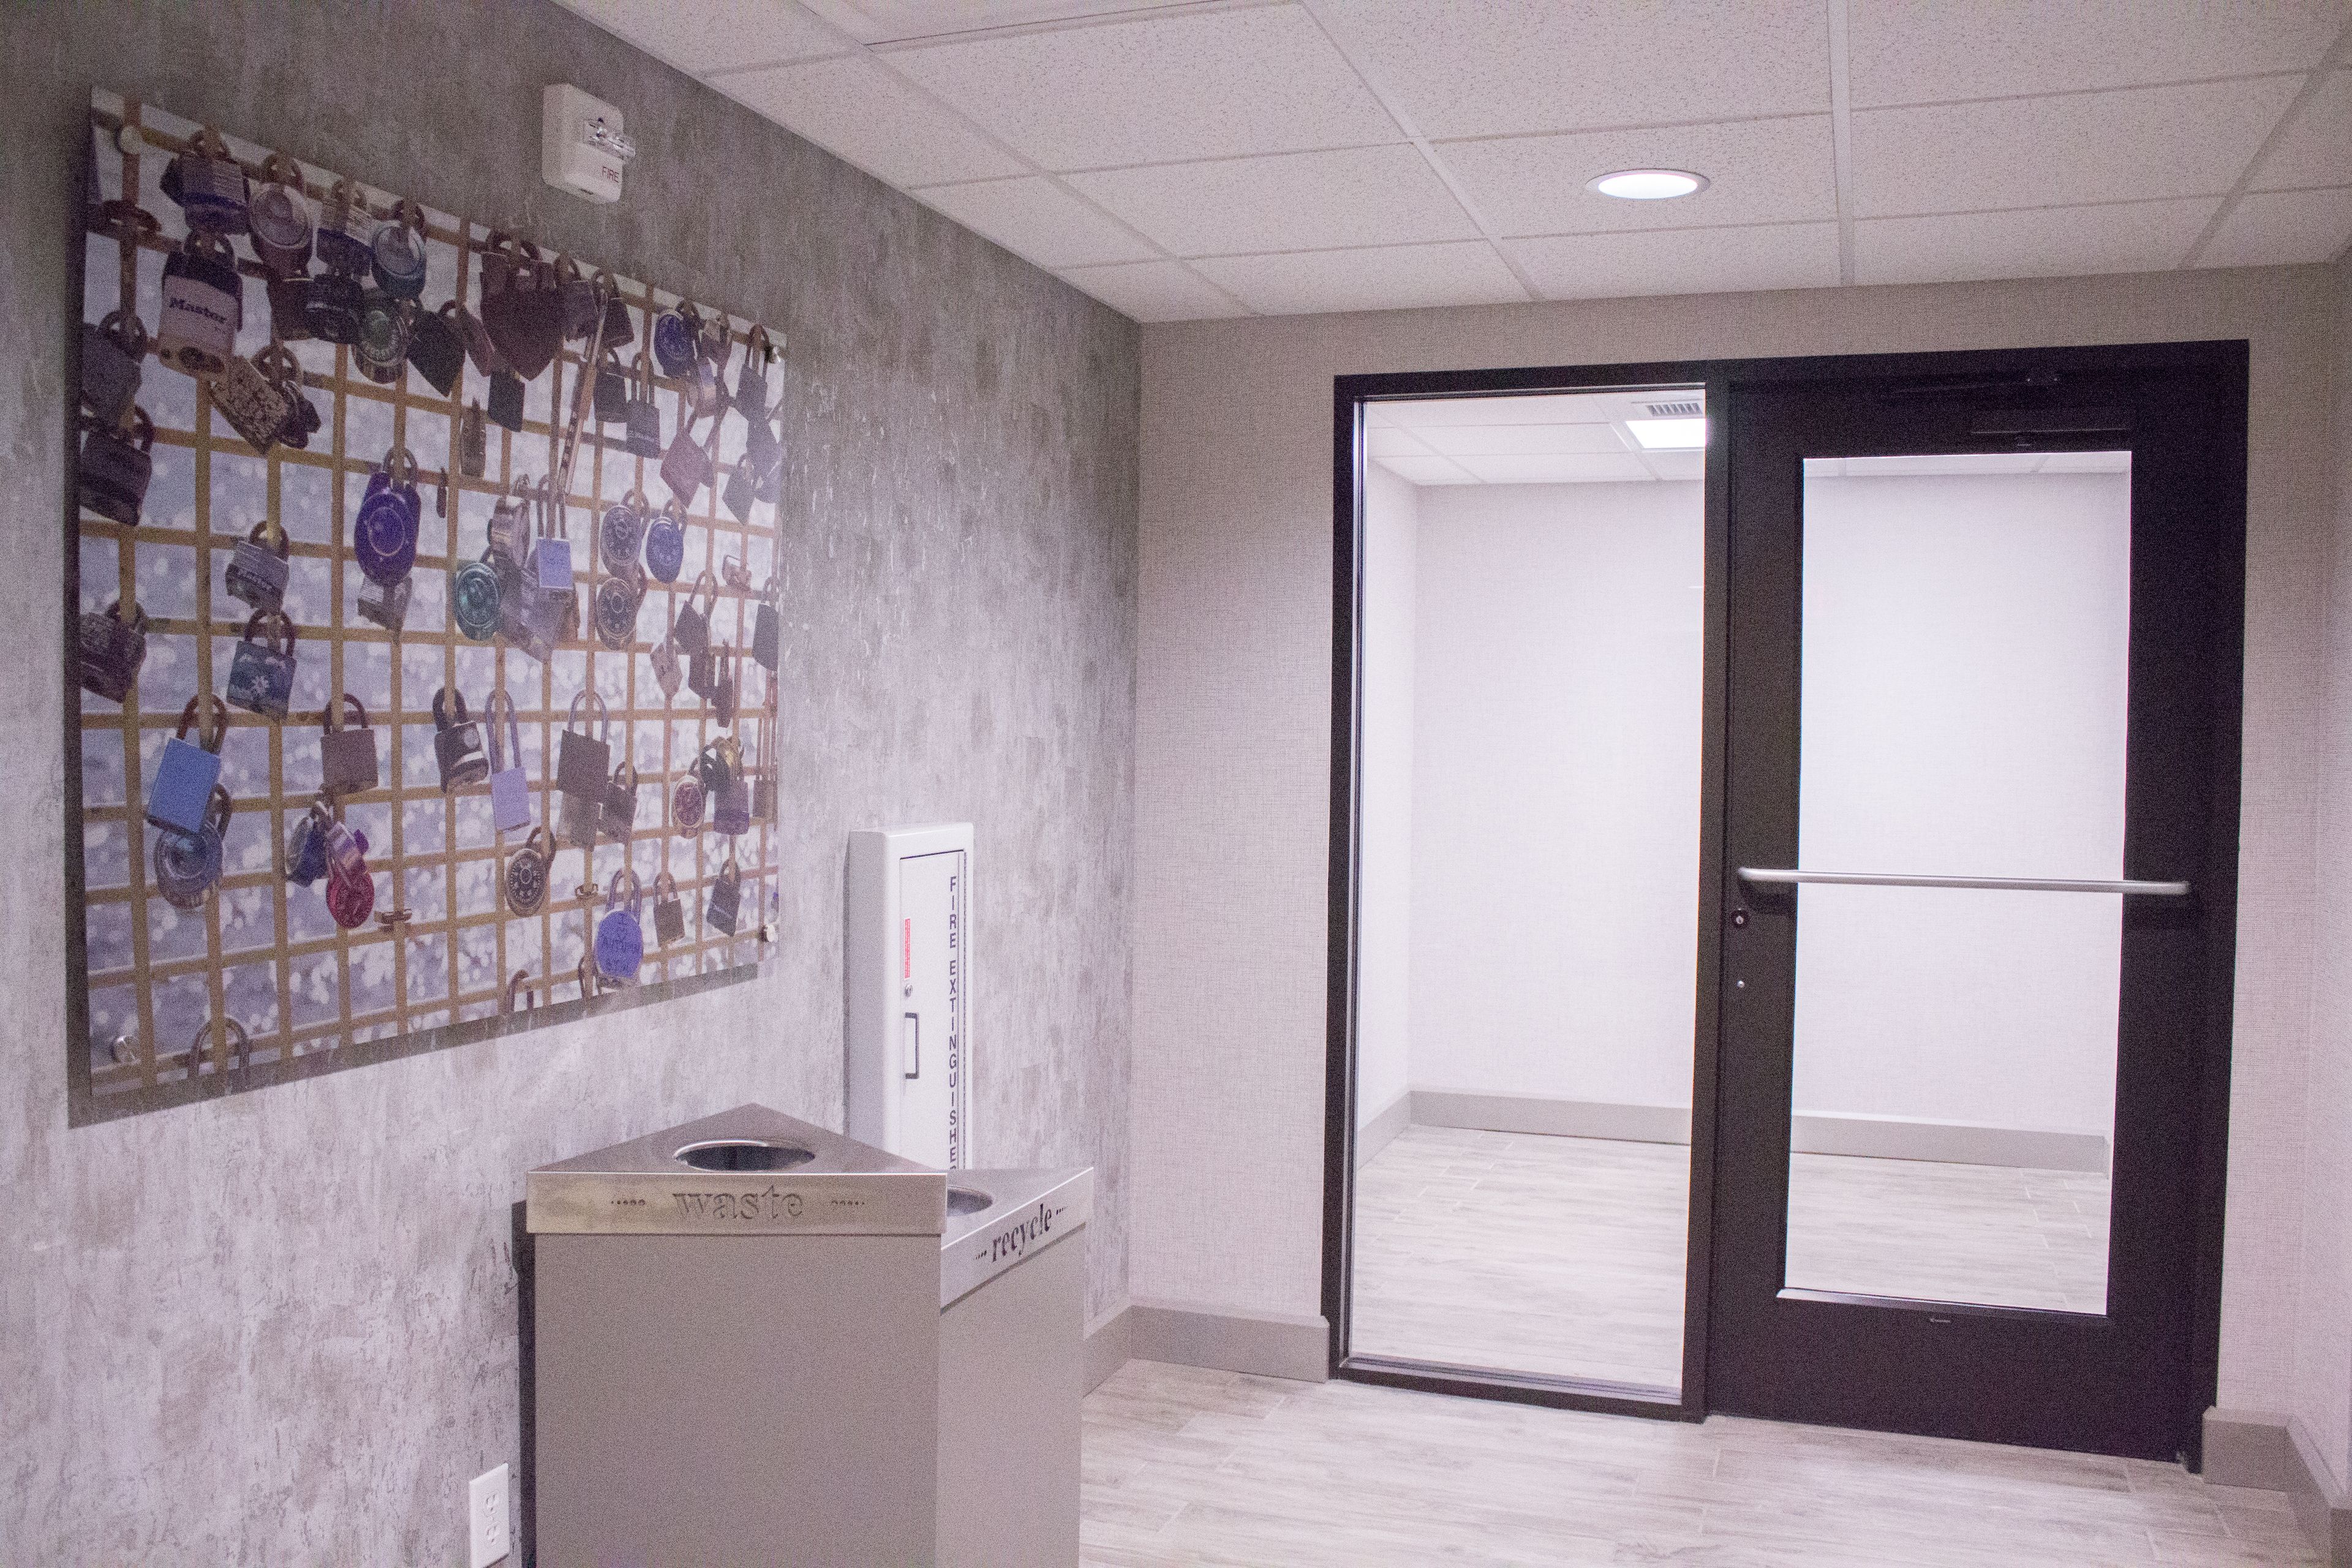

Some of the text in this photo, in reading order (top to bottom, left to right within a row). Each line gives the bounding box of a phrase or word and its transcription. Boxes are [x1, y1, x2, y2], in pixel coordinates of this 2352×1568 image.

[601, 166, 620, 183] FIRE
[169, 296, 227, 324] Master
[949, 875, 957, 1170] FIRE EXTINGUISHE
[672, 1184, 803, 1219] waste
[991, 1202, 1052, 1263] recycle
